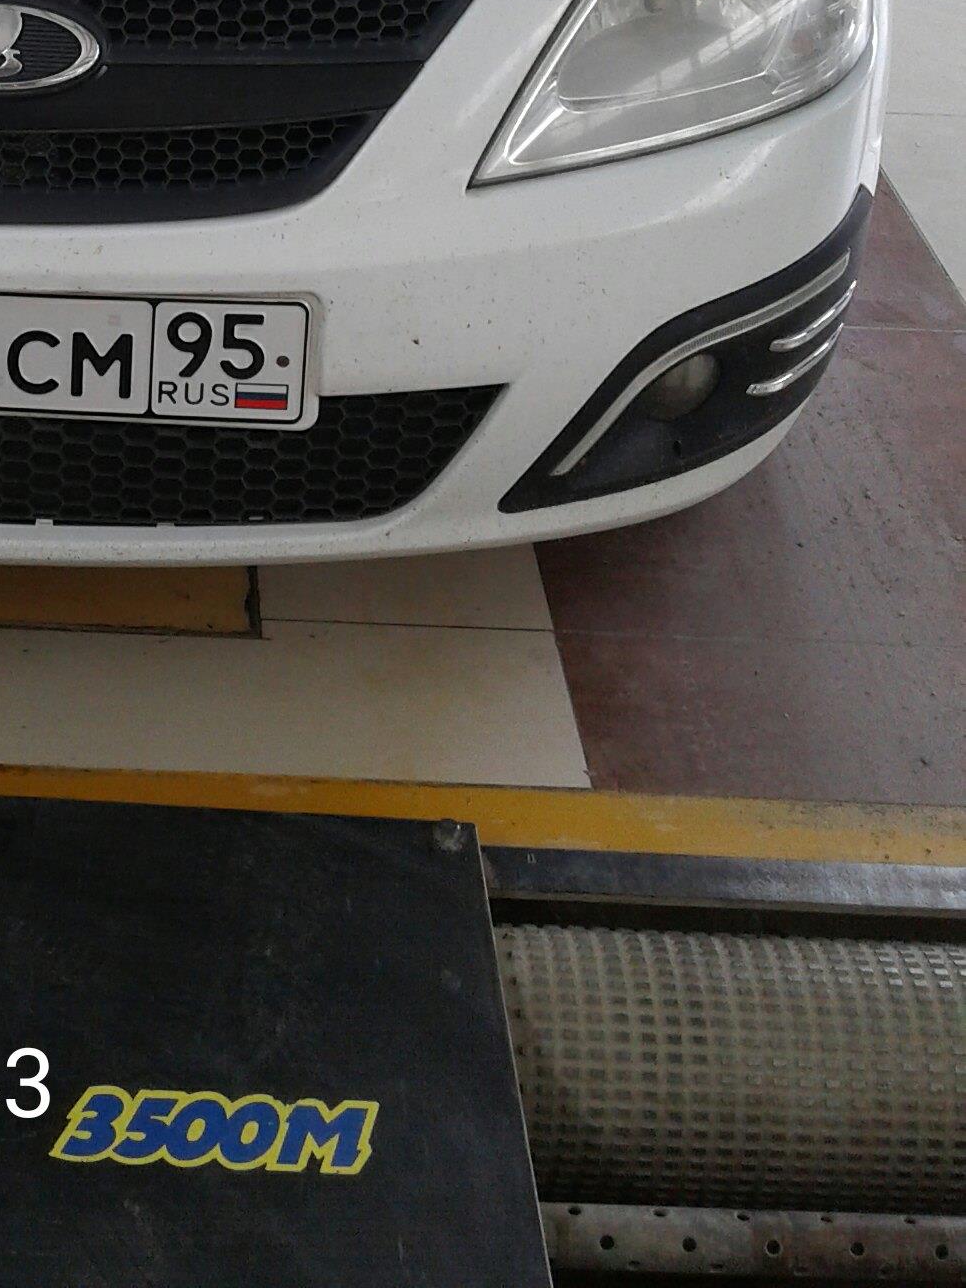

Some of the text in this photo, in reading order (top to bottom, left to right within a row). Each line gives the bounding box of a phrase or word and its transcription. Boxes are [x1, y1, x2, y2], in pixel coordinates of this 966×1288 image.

[166, 311, 265, 380] 95
[157, 380, 230, 407] RUS
[48, 1085, 380, 1175] 3500M
